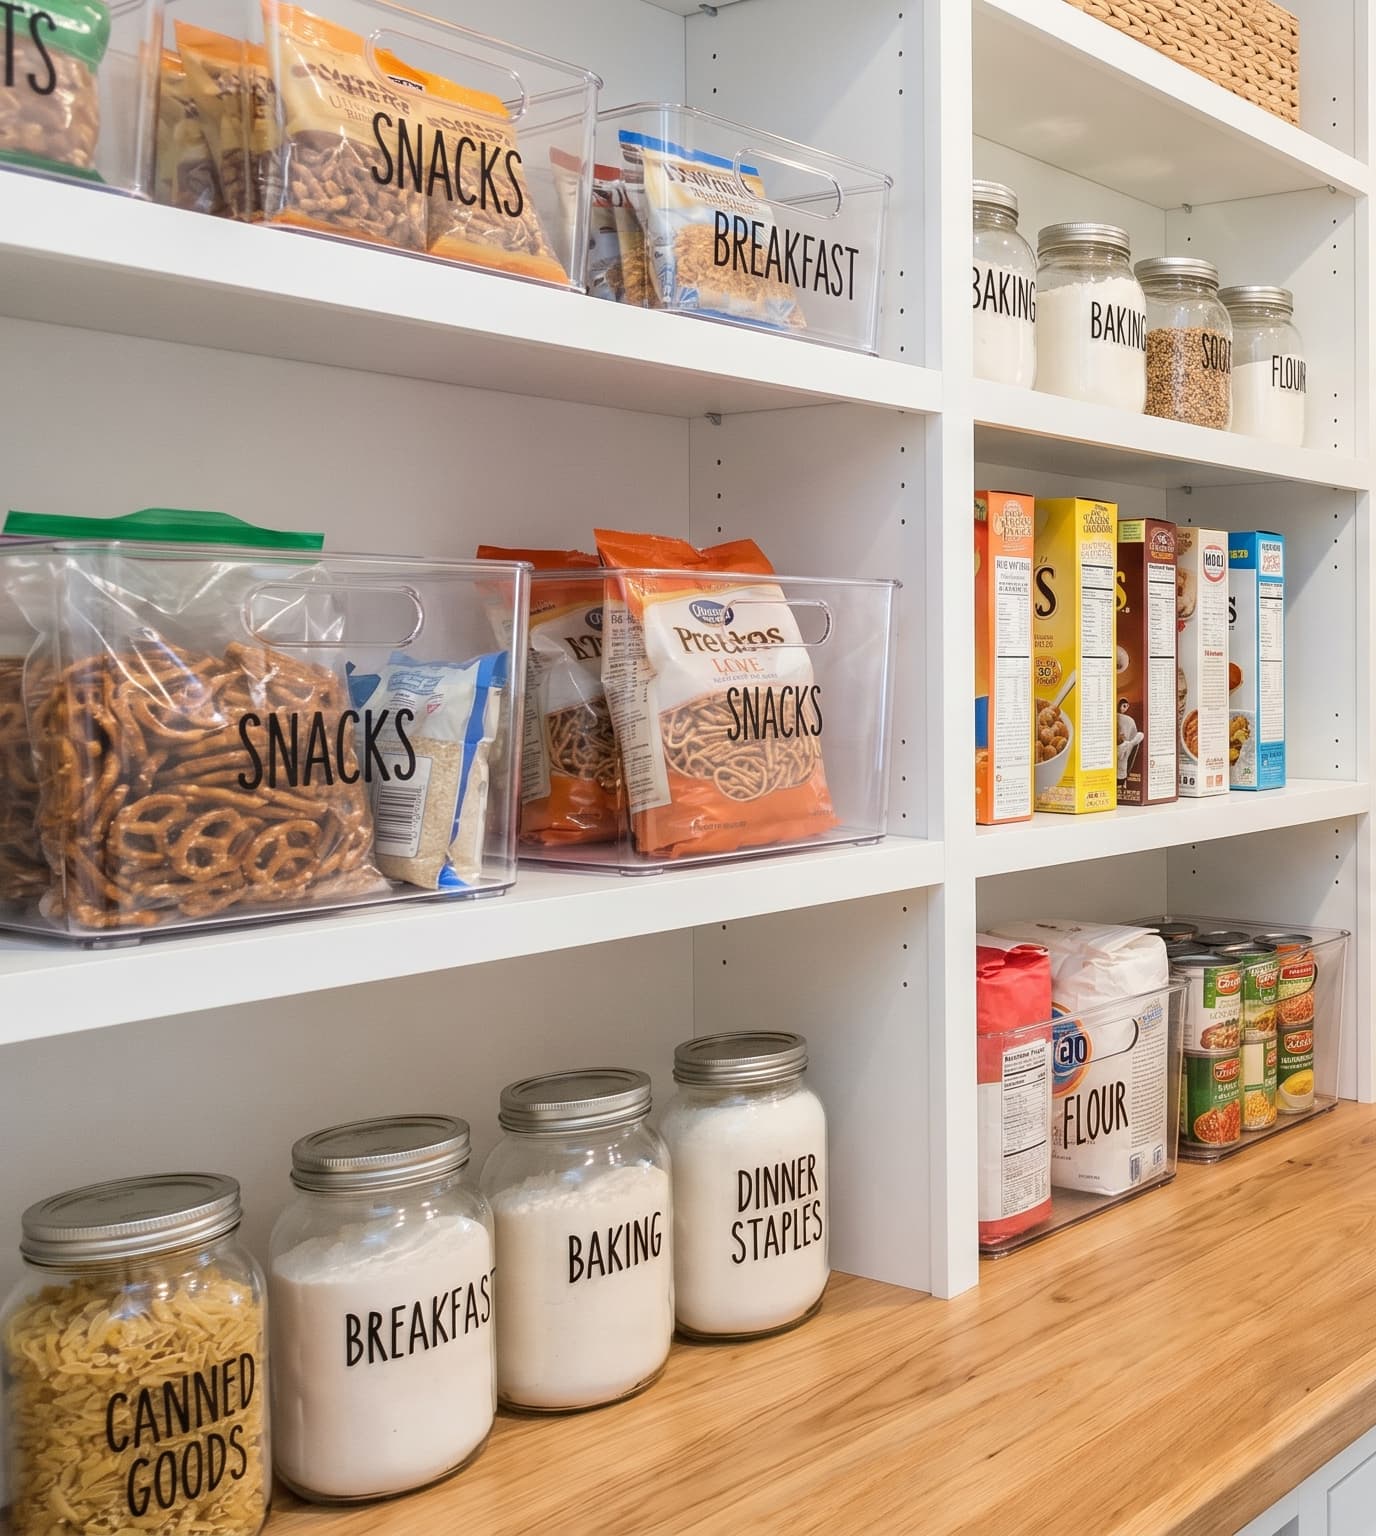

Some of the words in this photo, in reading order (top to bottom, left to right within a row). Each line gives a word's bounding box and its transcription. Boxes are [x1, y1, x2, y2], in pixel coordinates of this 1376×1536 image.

[371, 111, 524, 219] SNACKS
[713, 210, 859, 300] BREAKFAST
[1091, 301, 1146, 352] BAKING
[726, 685, 823, 740] SNACKS
[238, 708, 417, 790] SNACKS
[1063, 1080, 1129, 1150] FLOUR
[738, 1153, 819, 1213] DINNER
[568, 1211, 662, 1283] BAKING
[732, 1200, 823, 1264] STAPLES
[105, 1352, 255, 1452] CANNED
[127, 1424, 247, 1518] GOODS
